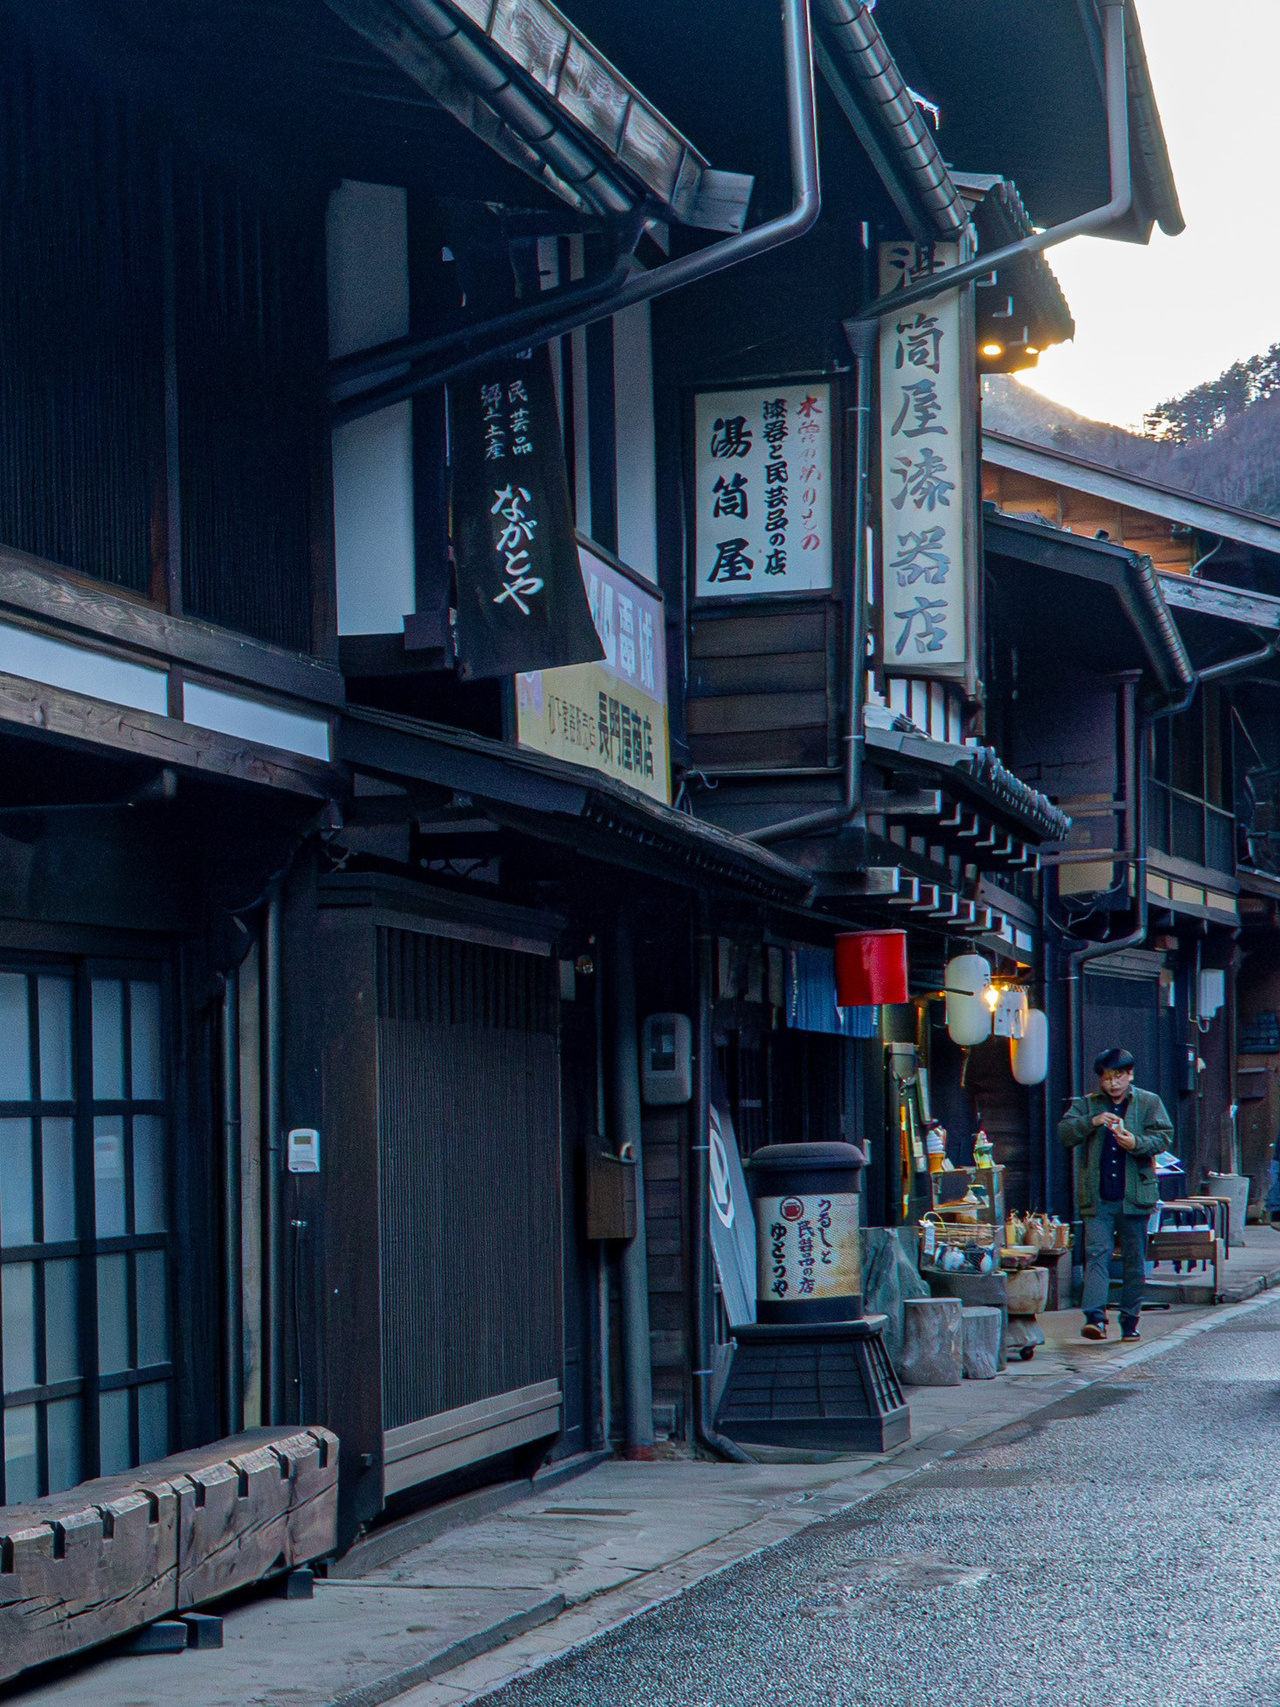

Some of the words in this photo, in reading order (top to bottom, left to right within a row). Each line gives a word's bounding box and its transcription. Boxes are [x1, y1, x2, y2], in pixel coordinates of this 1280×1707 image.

[508, 380, 533, 455] 民芸品
[889, 241, 955, 656] 湯筒屋漆器店
[490, 484, 545, 615] ながとや
[707, 415, 753, 583] 湯筒屋
[762, 398, 789, 576] 漆器と民芸品の店
[598, 691, 655, 781] 長門屋商店
[770, 1222, 789, 1298] ゆとうや
